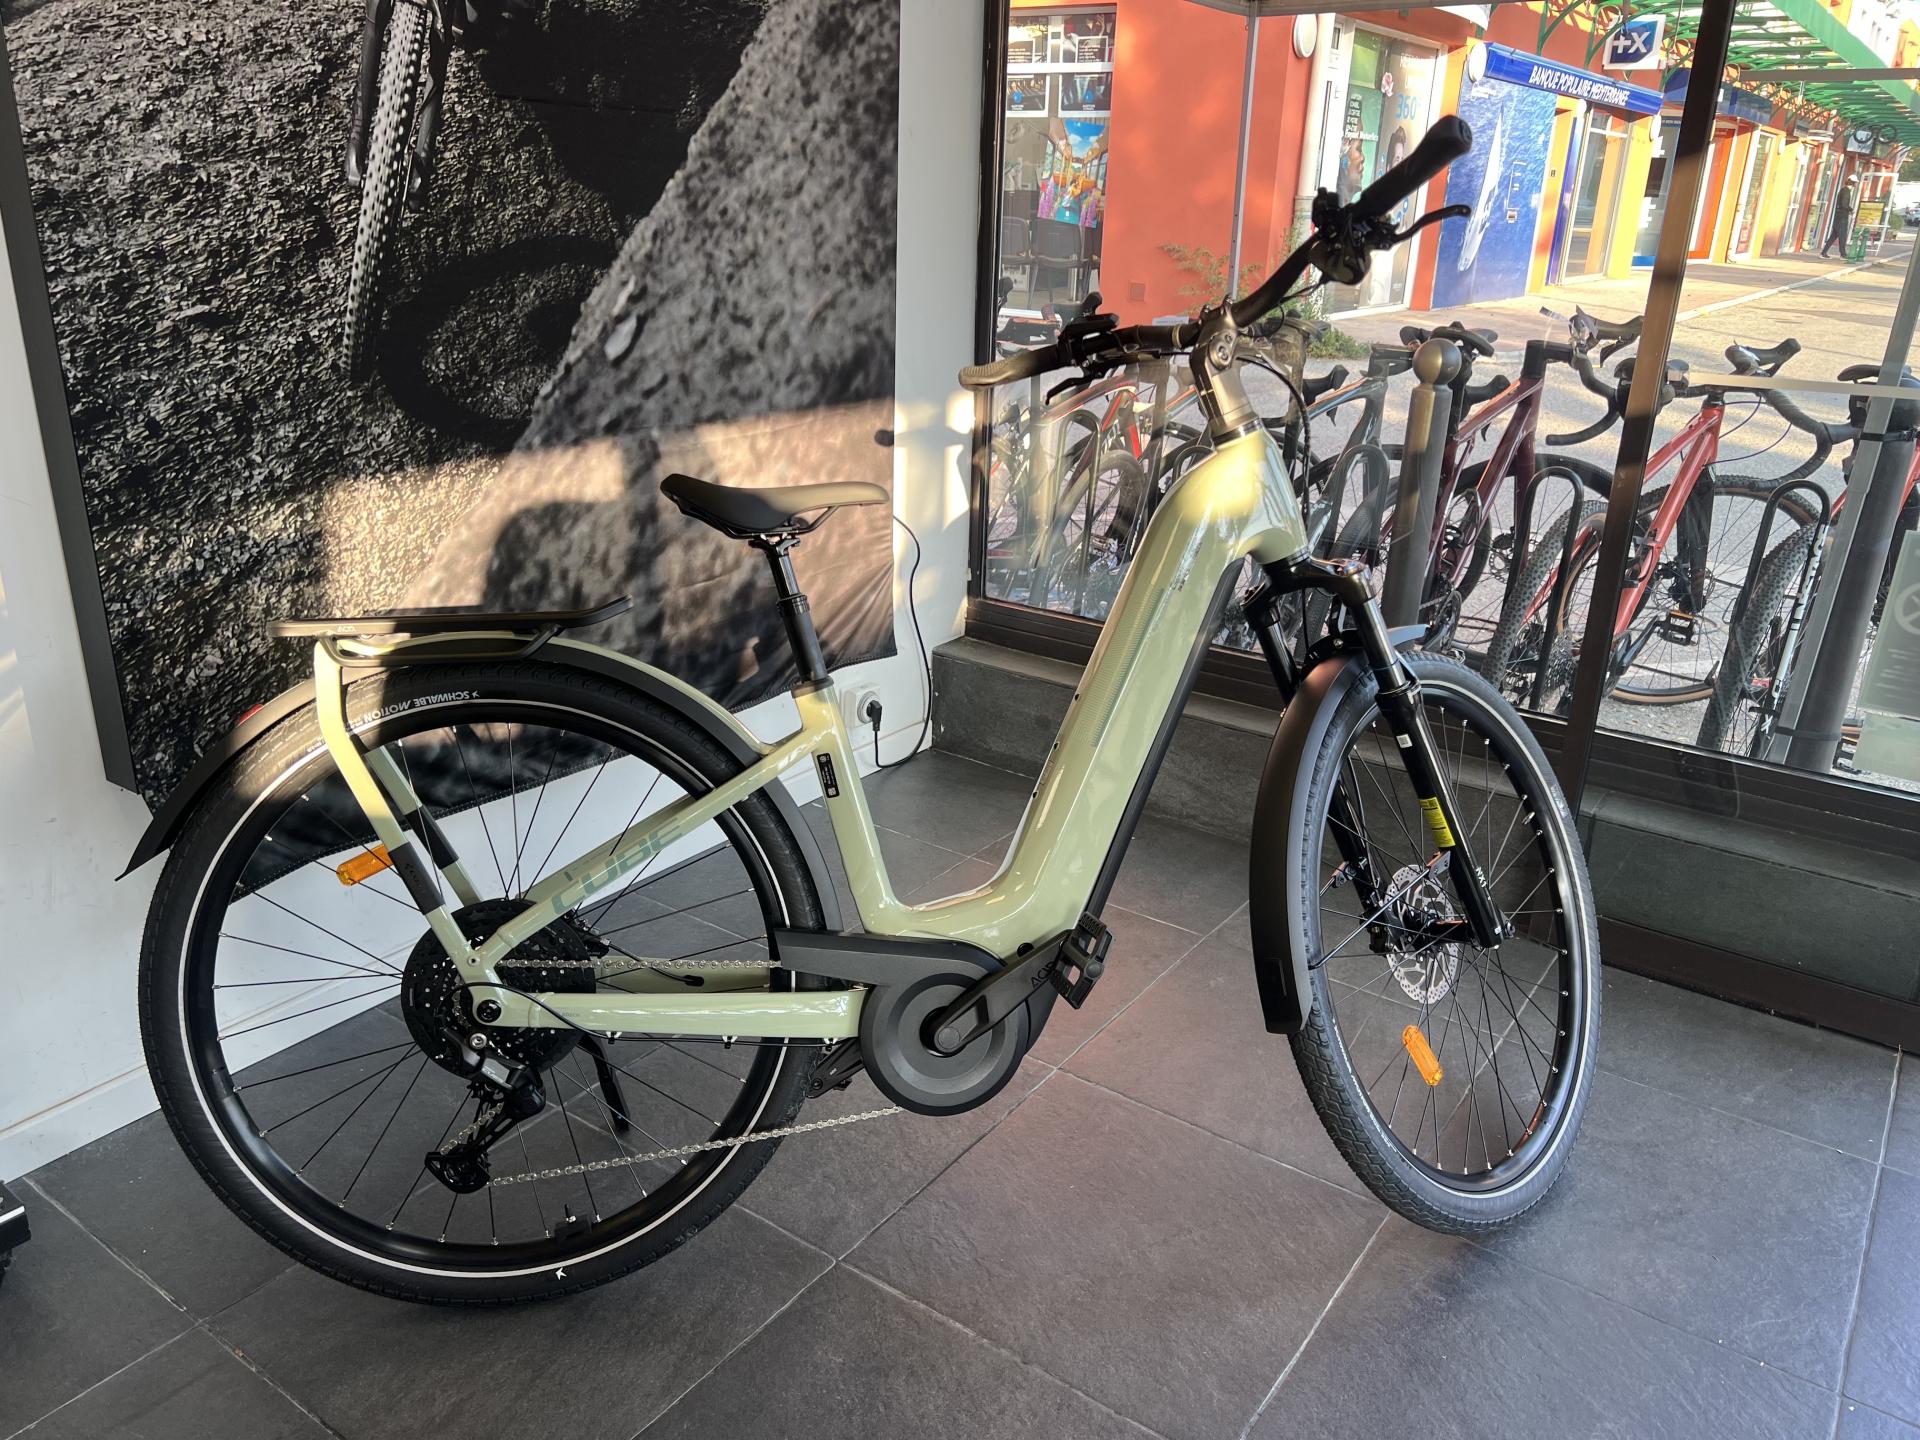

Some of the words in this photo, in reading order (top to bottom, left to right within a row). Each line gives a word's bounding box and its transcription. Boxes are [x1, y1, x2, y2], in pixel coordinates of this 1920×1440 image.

[1528, 65, 1559, 90] BANQUE
[1558, 71, 1593, 98] POPULAIRE
[363, 699, 411, 724] MOTION
[414, 690, 470, 708] SCHWALBE
[551, 816, 682, 915] CUBE
[1031, 961, 1058, 989] ACID
